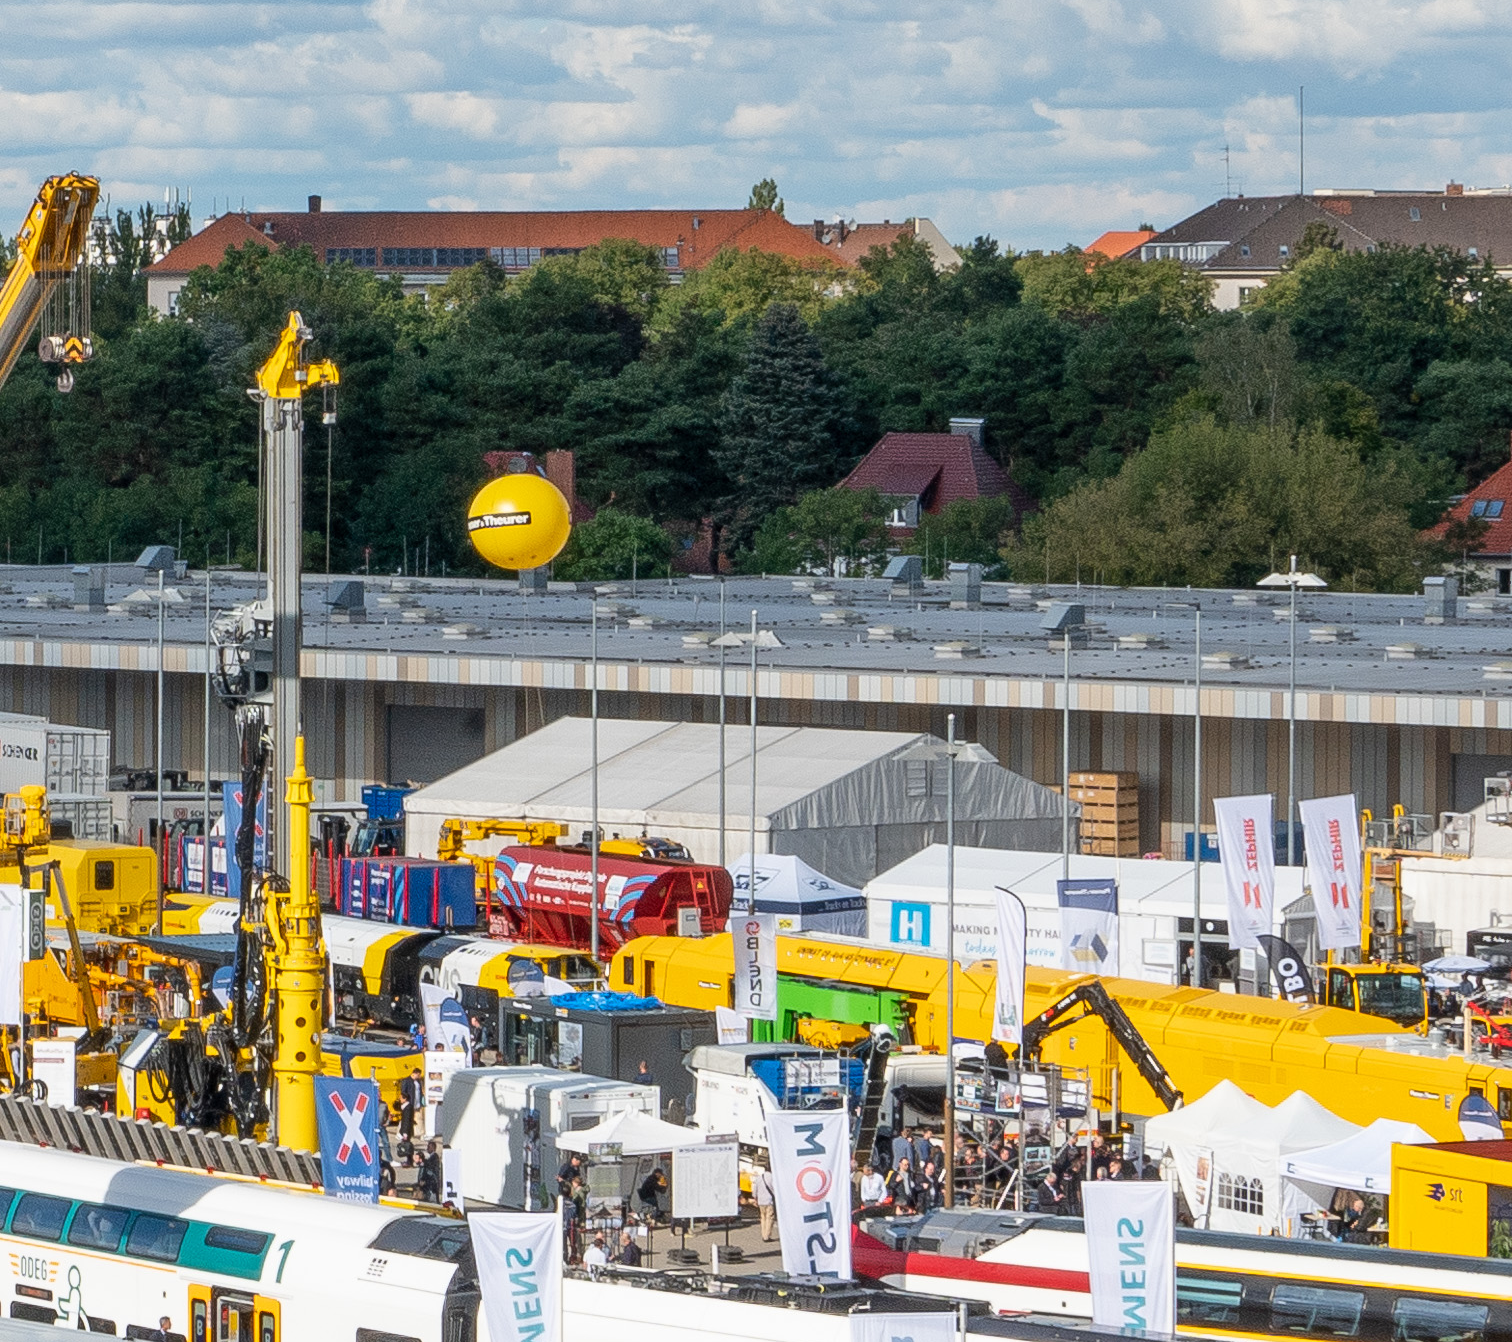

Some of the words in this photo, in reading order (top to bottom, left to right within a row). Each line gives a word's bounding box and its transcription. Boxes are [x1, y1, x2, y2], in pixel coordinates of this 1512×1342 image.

[952, 923, 991, 935] MAKING
[1449, 1187, 1463, 1203] srt
[20, 1255, 48, 1280] ODEG
[275, 1240, 294, 1283] 1
